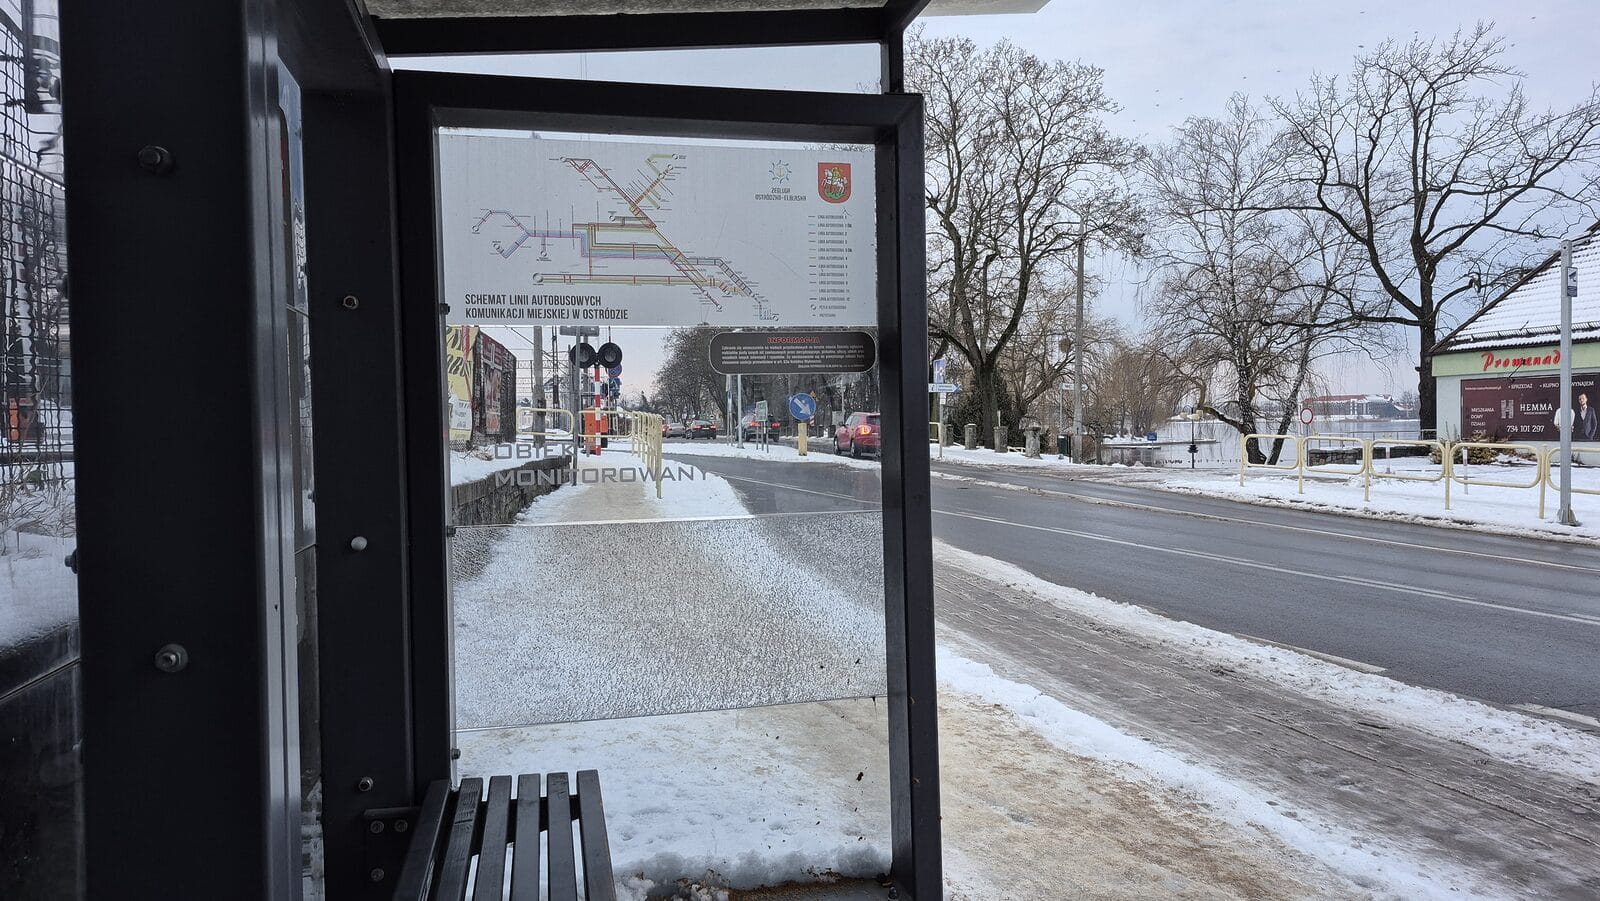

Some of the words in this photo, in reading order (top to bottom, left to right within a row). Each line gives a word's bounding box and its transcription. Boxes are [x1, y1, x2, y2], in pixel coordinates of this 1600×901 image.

[465, 294, 506, 305] SCHEMAT
[509, 295, 529, 305] LINII
[531, 295, 601, 306] AUTOBUSOWYCH
[465, 308, 524, 319] KOMUNIKACJI
[527, 308, 570, 319] MIEJSKIEJ
[572, 309, 580, 319] W
[582, 307, 629, 320] OSTRÓDZIE
[1481, 349, 1561, 371] Promenad
[1520, 403, 1553, 411] HEMMA
[1506, 425, 1518, 433] 734
[1532, 424, 1545, 433] 297
[495, 465, 708, 487] MONITOROWANY
